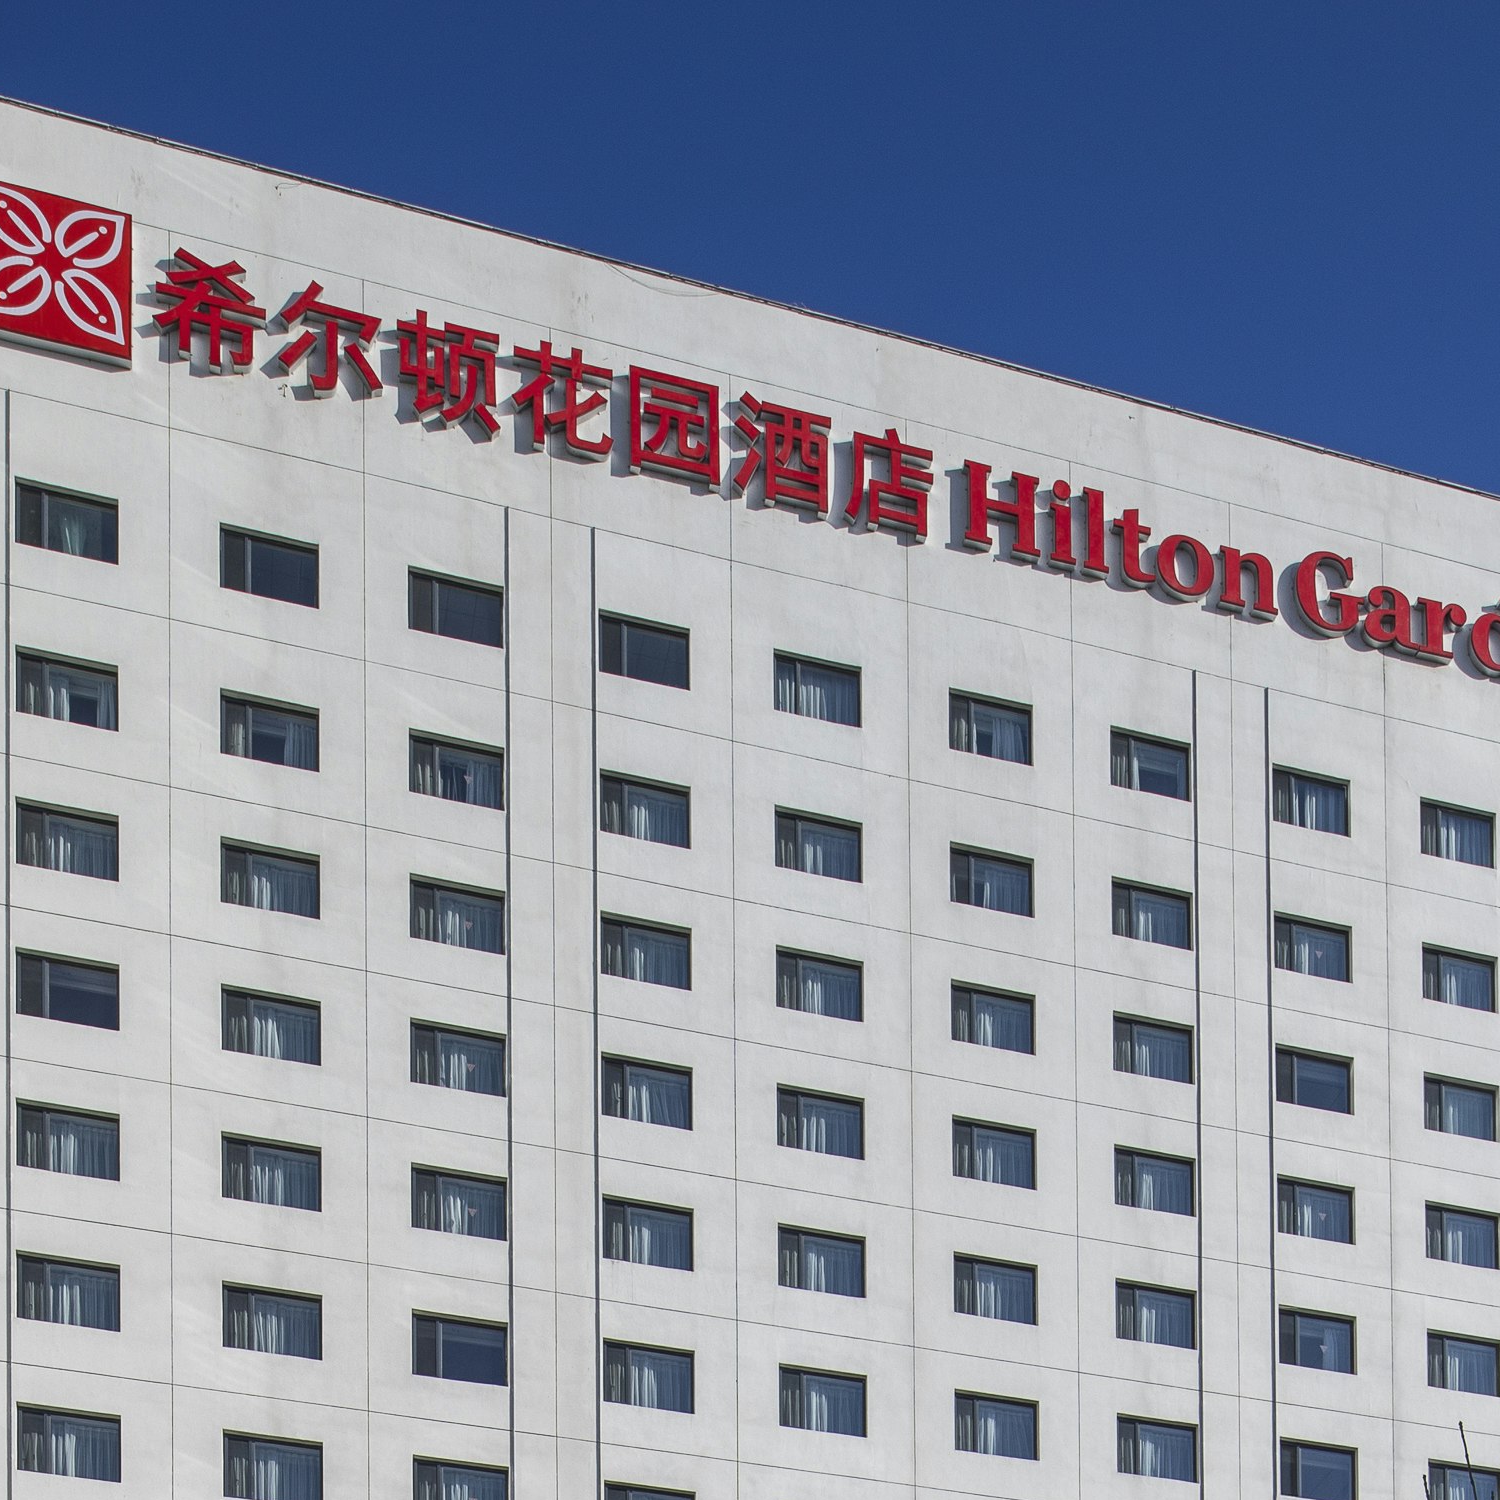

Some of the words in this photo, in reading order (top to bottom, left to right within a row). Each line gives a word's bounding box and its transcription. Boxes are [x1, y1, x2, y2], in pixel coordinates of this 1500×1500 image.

[153, 247, 935, 543] 希尔顿花园酒店
[963, 459, 1279, 619] Hilton
